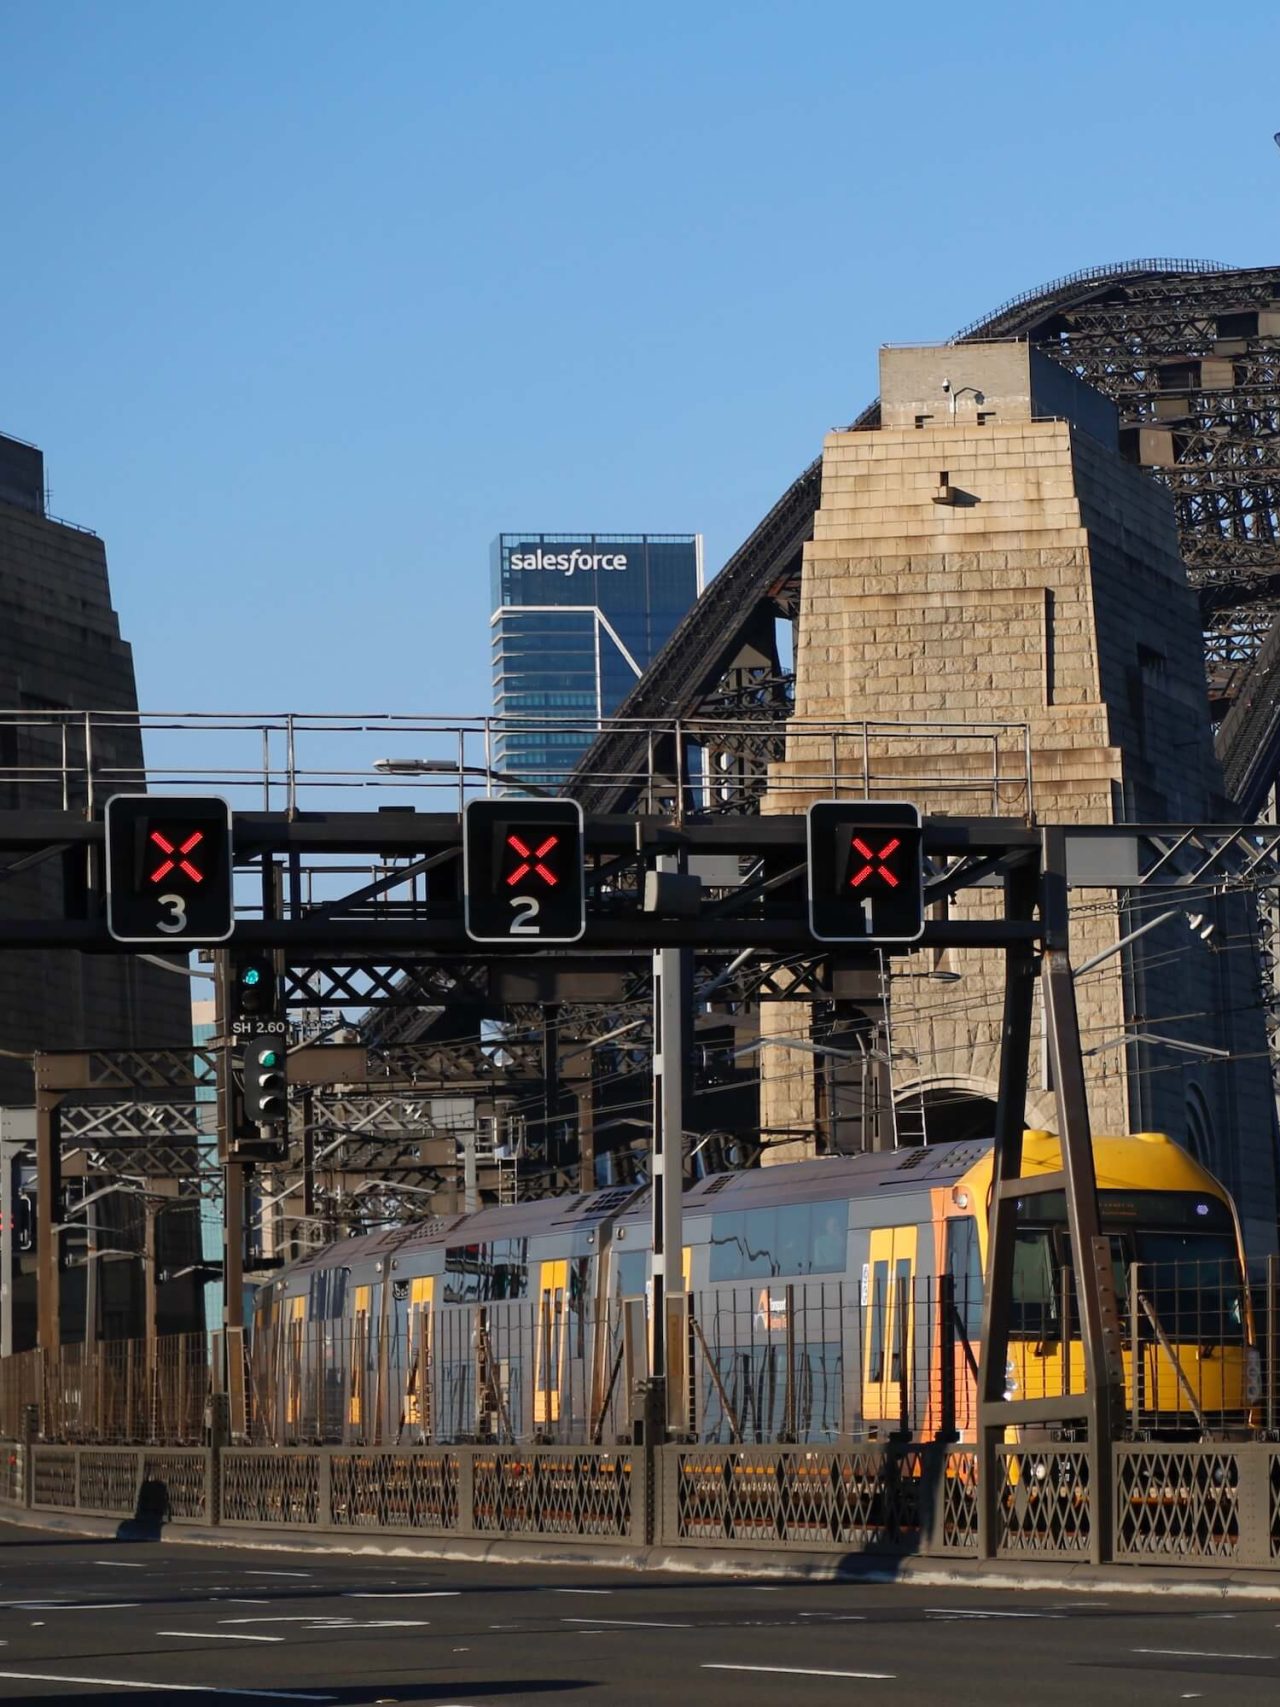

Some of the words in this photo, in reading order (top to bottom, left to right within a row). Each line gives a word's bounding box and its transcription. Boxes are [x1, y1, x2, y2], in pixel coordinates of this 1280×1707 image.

[511, 549, 627, 576] salesforce
[157, 894, 187, 933] 3
[510, 896, 540, 934] 2
[860, 897, 873, 934] 1
[232, 1022, 251, 1033] SH
[256, 1022, 285, 1033] 2.60
